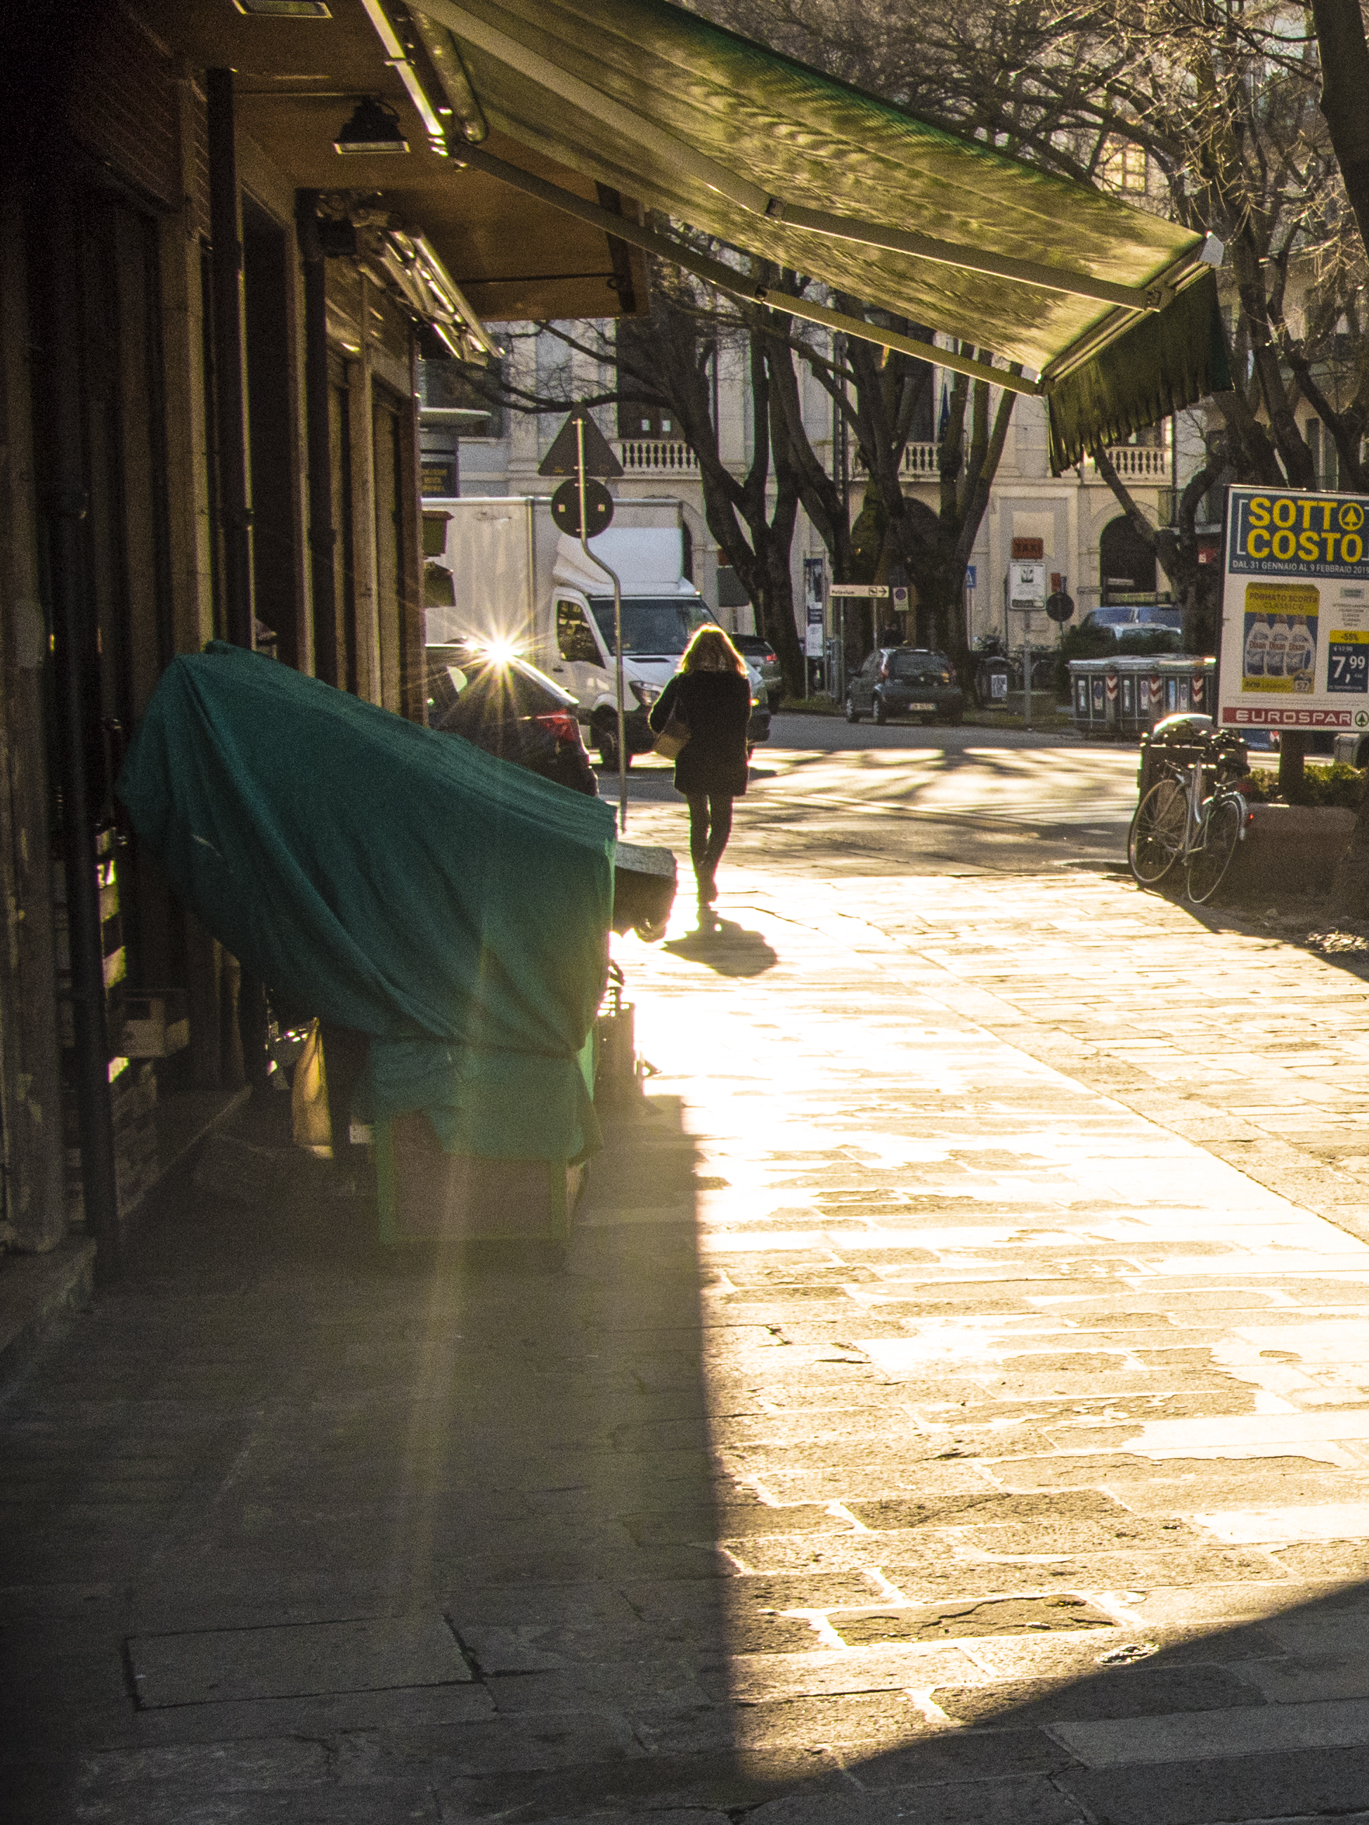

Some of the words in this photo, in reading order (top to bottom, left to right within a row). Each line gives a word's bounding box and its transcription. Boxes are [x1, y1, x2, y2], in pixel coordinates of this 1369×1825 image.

[1247, 528, 1363, 563] COSTO
[1232, 561, 1248, 569] DAL
[1250, 561, 1259, 569] 31
[1261, 562, 1297, 571] GENNAIO
[1299, 563, 1308, 571] AL
[1310, 564, 1315, 572] 9
[1316, 564, 1352, 573] FEBBRAIO
[1235, 710, 1352, 724] EUROSPAR
